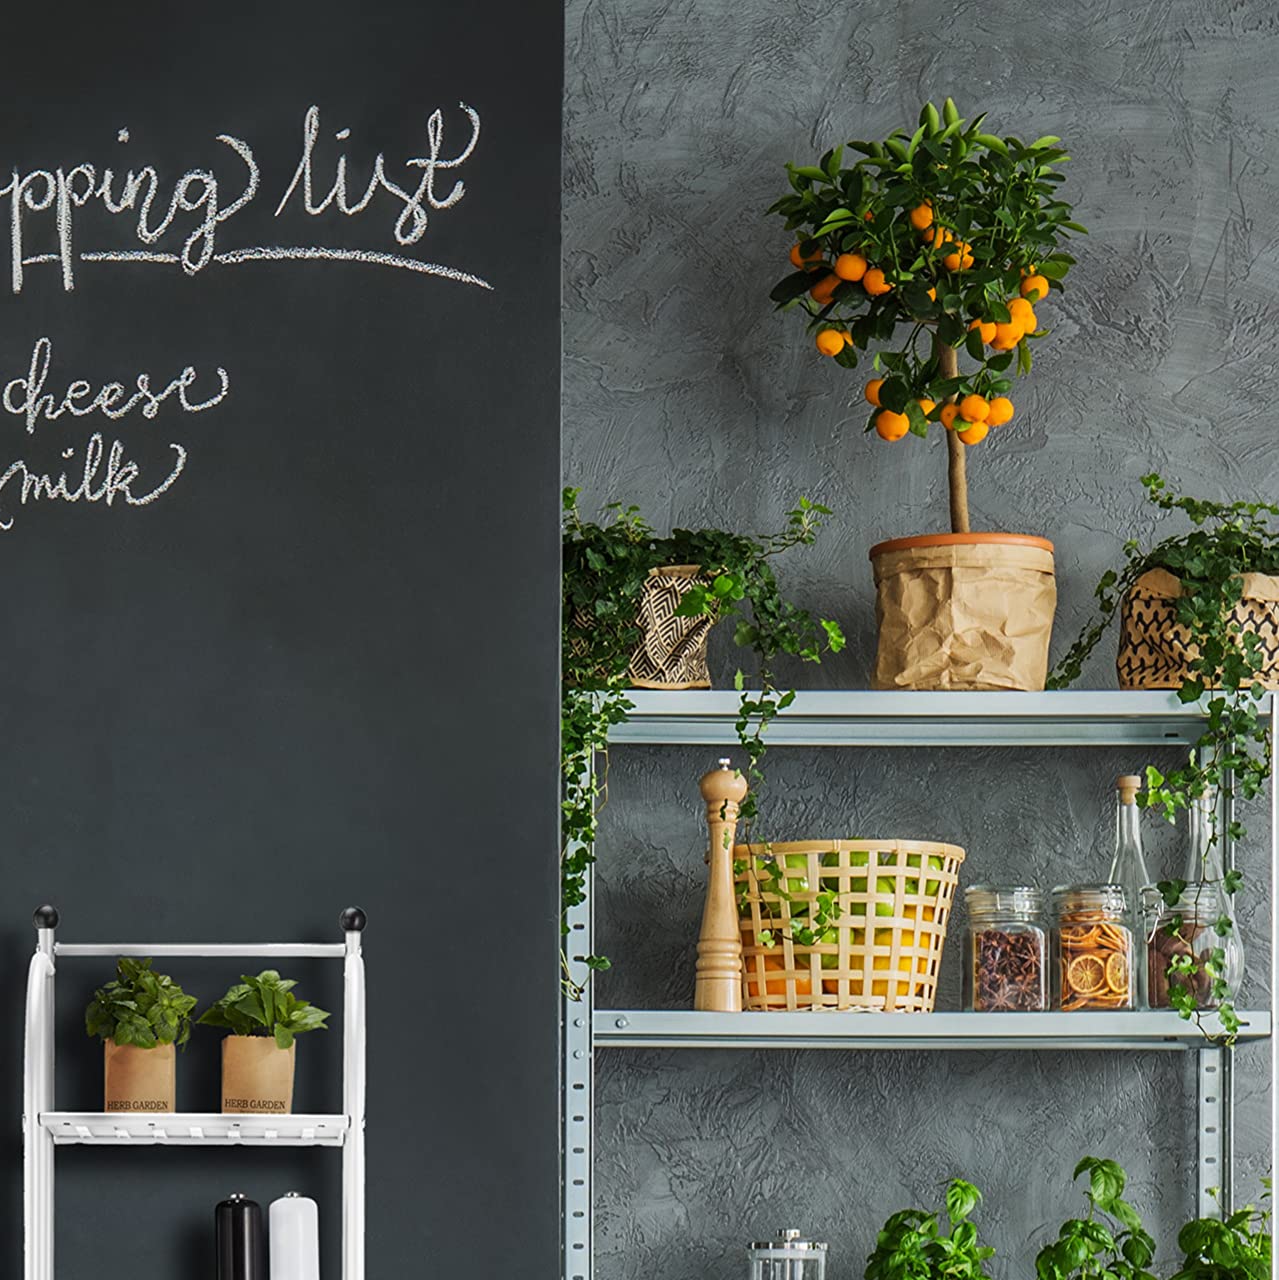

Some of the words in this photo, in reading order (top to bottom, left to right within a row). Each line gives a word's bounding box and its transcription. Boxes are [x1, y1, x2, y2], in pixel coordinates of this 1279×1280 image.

[274, 102, 480, 246] list
[3, 337, 229, 434] cheese
[107, 1100, 131, 1111] HERB
[132, 1101, 169, 1111] GARDEN
[224, 1098, 249, 1109] HERB
[249, 1099, 286, 1110] GARDEN
